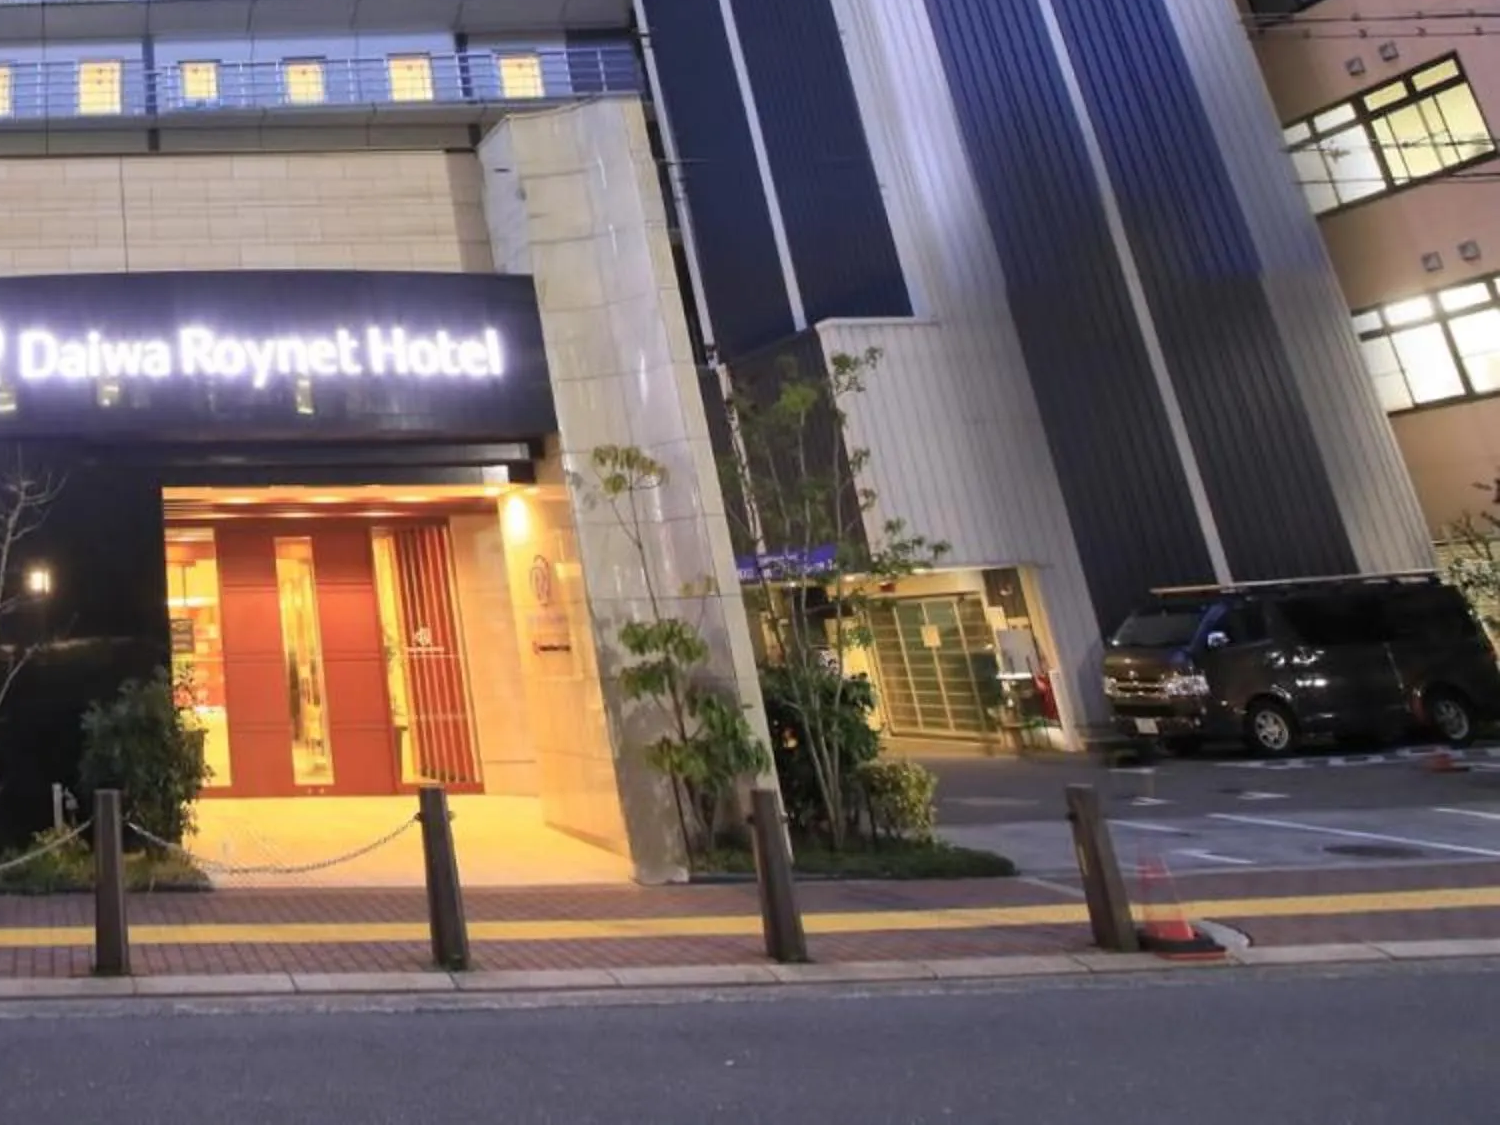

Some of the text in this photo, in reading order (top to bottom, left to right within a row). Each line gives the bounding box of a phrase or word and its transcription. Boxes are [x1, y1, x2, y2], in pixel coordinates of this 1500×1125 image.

[18, 329, 172, 378] Daiwa
[178, 323, 363, 389] Roynet
[366, 326, 504, 377] Hotel
